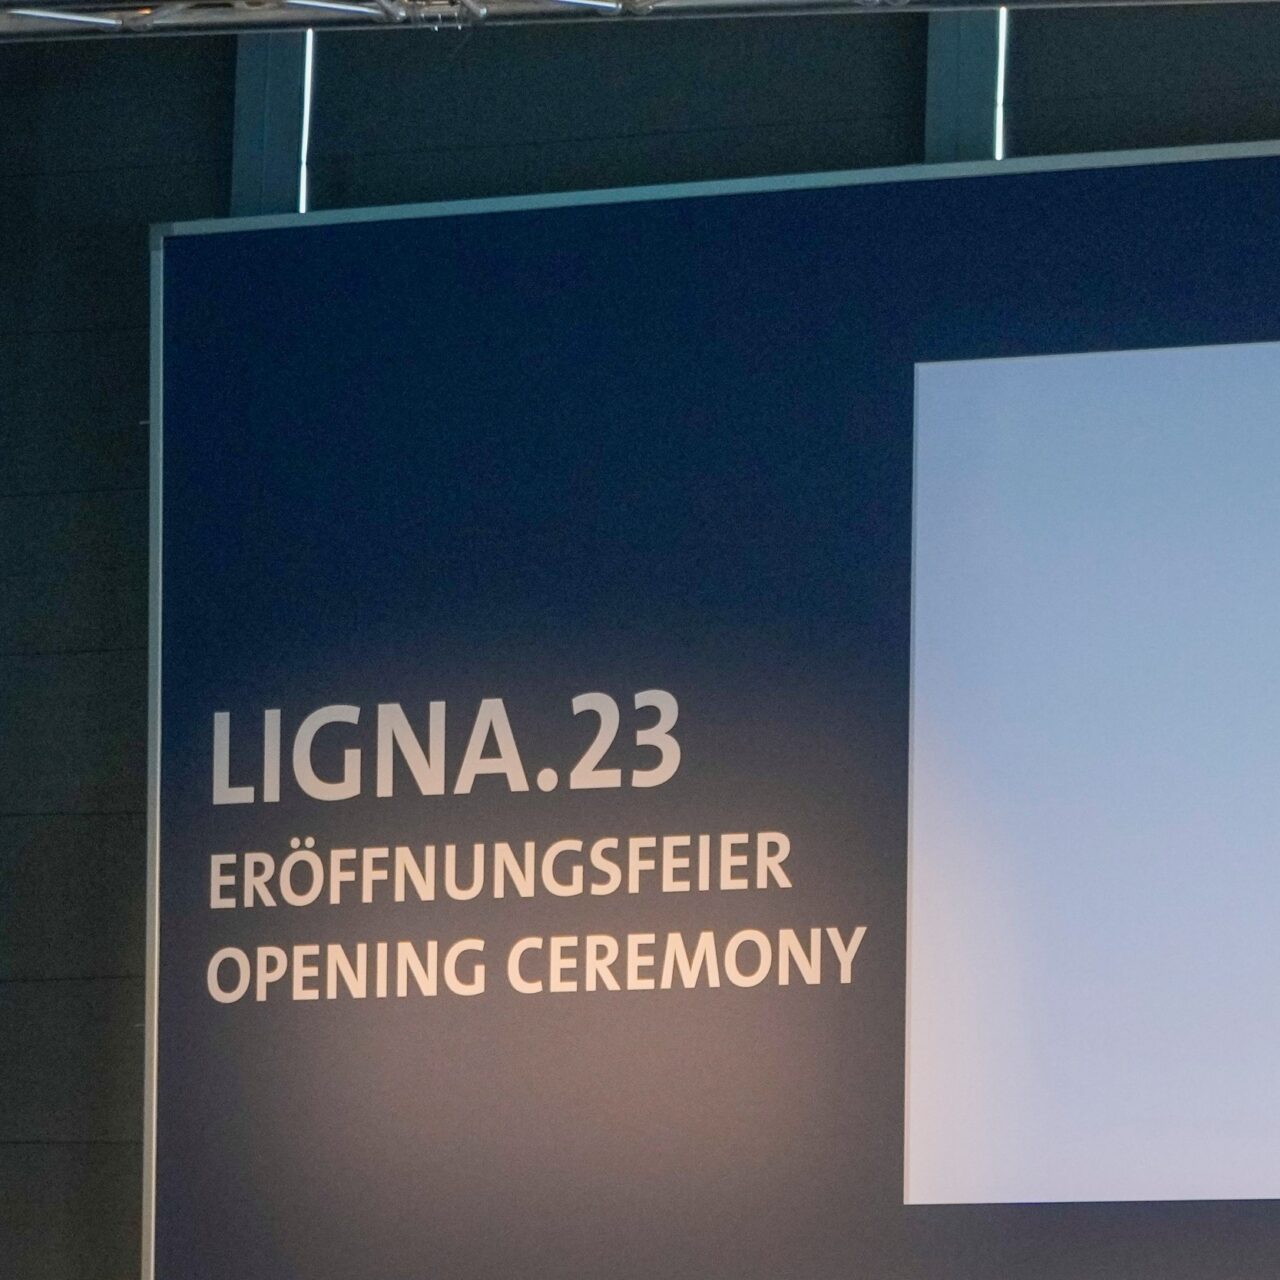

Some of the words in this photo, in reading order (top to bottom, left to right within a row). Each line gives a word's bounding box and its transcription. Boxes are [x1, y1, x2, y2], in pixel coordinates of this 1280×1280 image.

[213, 690, 680, 804] LIGNA.23
[210, 832, 792, 909] ERÖFFNUNGSFEIER
[207, 938, 486, 1004] OPENING
[507, 926, 868, 995] CEREMONY
